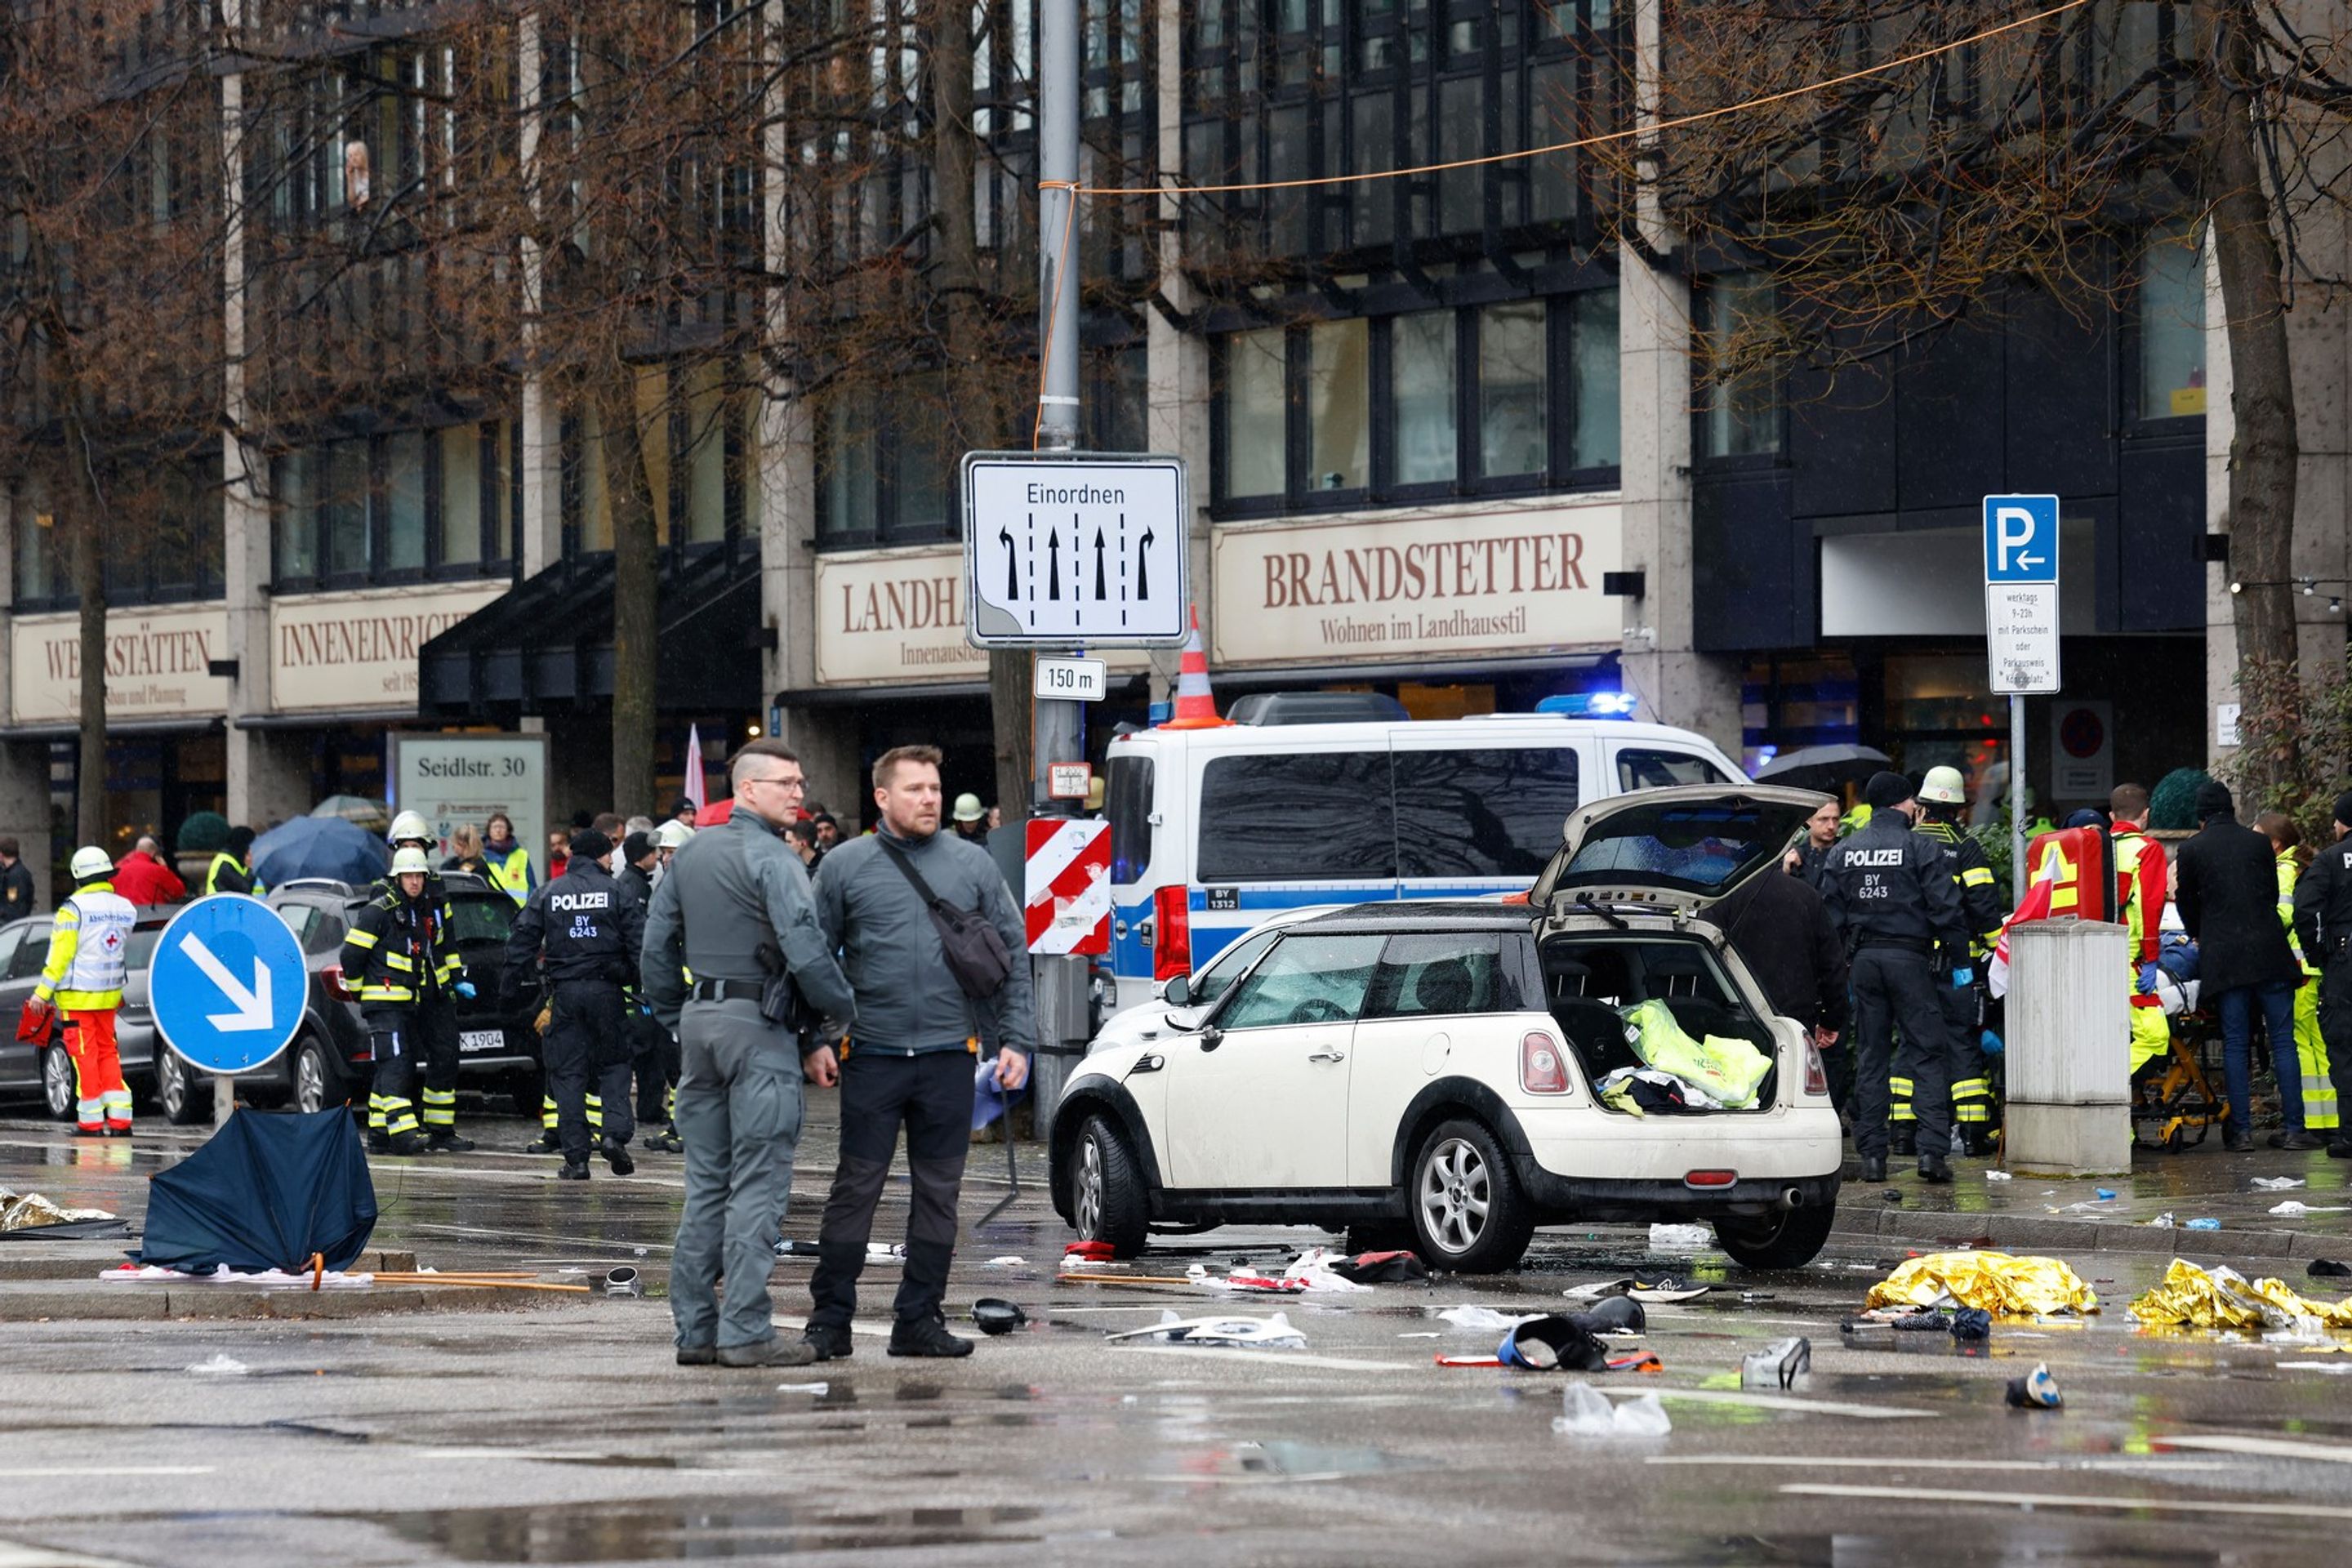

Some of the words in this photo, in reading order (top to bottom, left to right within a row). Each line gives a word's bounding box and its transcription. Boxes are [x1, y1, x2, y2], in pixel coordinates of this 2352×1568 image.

[1027, 483, 1125, 504] Einordnen
[1997, 507, 2035, 571] P
[1263, 532, 1588, 608] BRANDSTETTER
[2007, 593, 2038, 604] werktags
[1321, 616, 1387, 644] Wohnen
[1391, 613, 1413, 640] im
[1418, 605, 1526, 639] Landhausstil
[2011, 625, 2048, 635] Parkschein
[45, 622, 211, 680] WEKSTÄTTEN
[2016, 642, 2030, 651] oder
[2003, 657, 2044, 667] Parkausweis
[1048, 668, 1074, 688] 150
[1079, 675, 1093, 688] m
[418, 757, 494, 777] Seidlstr.
[502, 758, 525, 777] 30
[1845, 849, 1903, 867] POLIZEI
[1864, 874, 1880, 886] BY
[1215, 889, 1229, 898] BY
[1859, 886, 1887, 899] 6243
[551, 892, 608, 911] POLIZEI
[1211, 900, 1235, 908] 1312
[575, 915, 590, 927] BY
[569, 926, 598, 938] 6243
[471, 1032, 502, 1046] 1904
